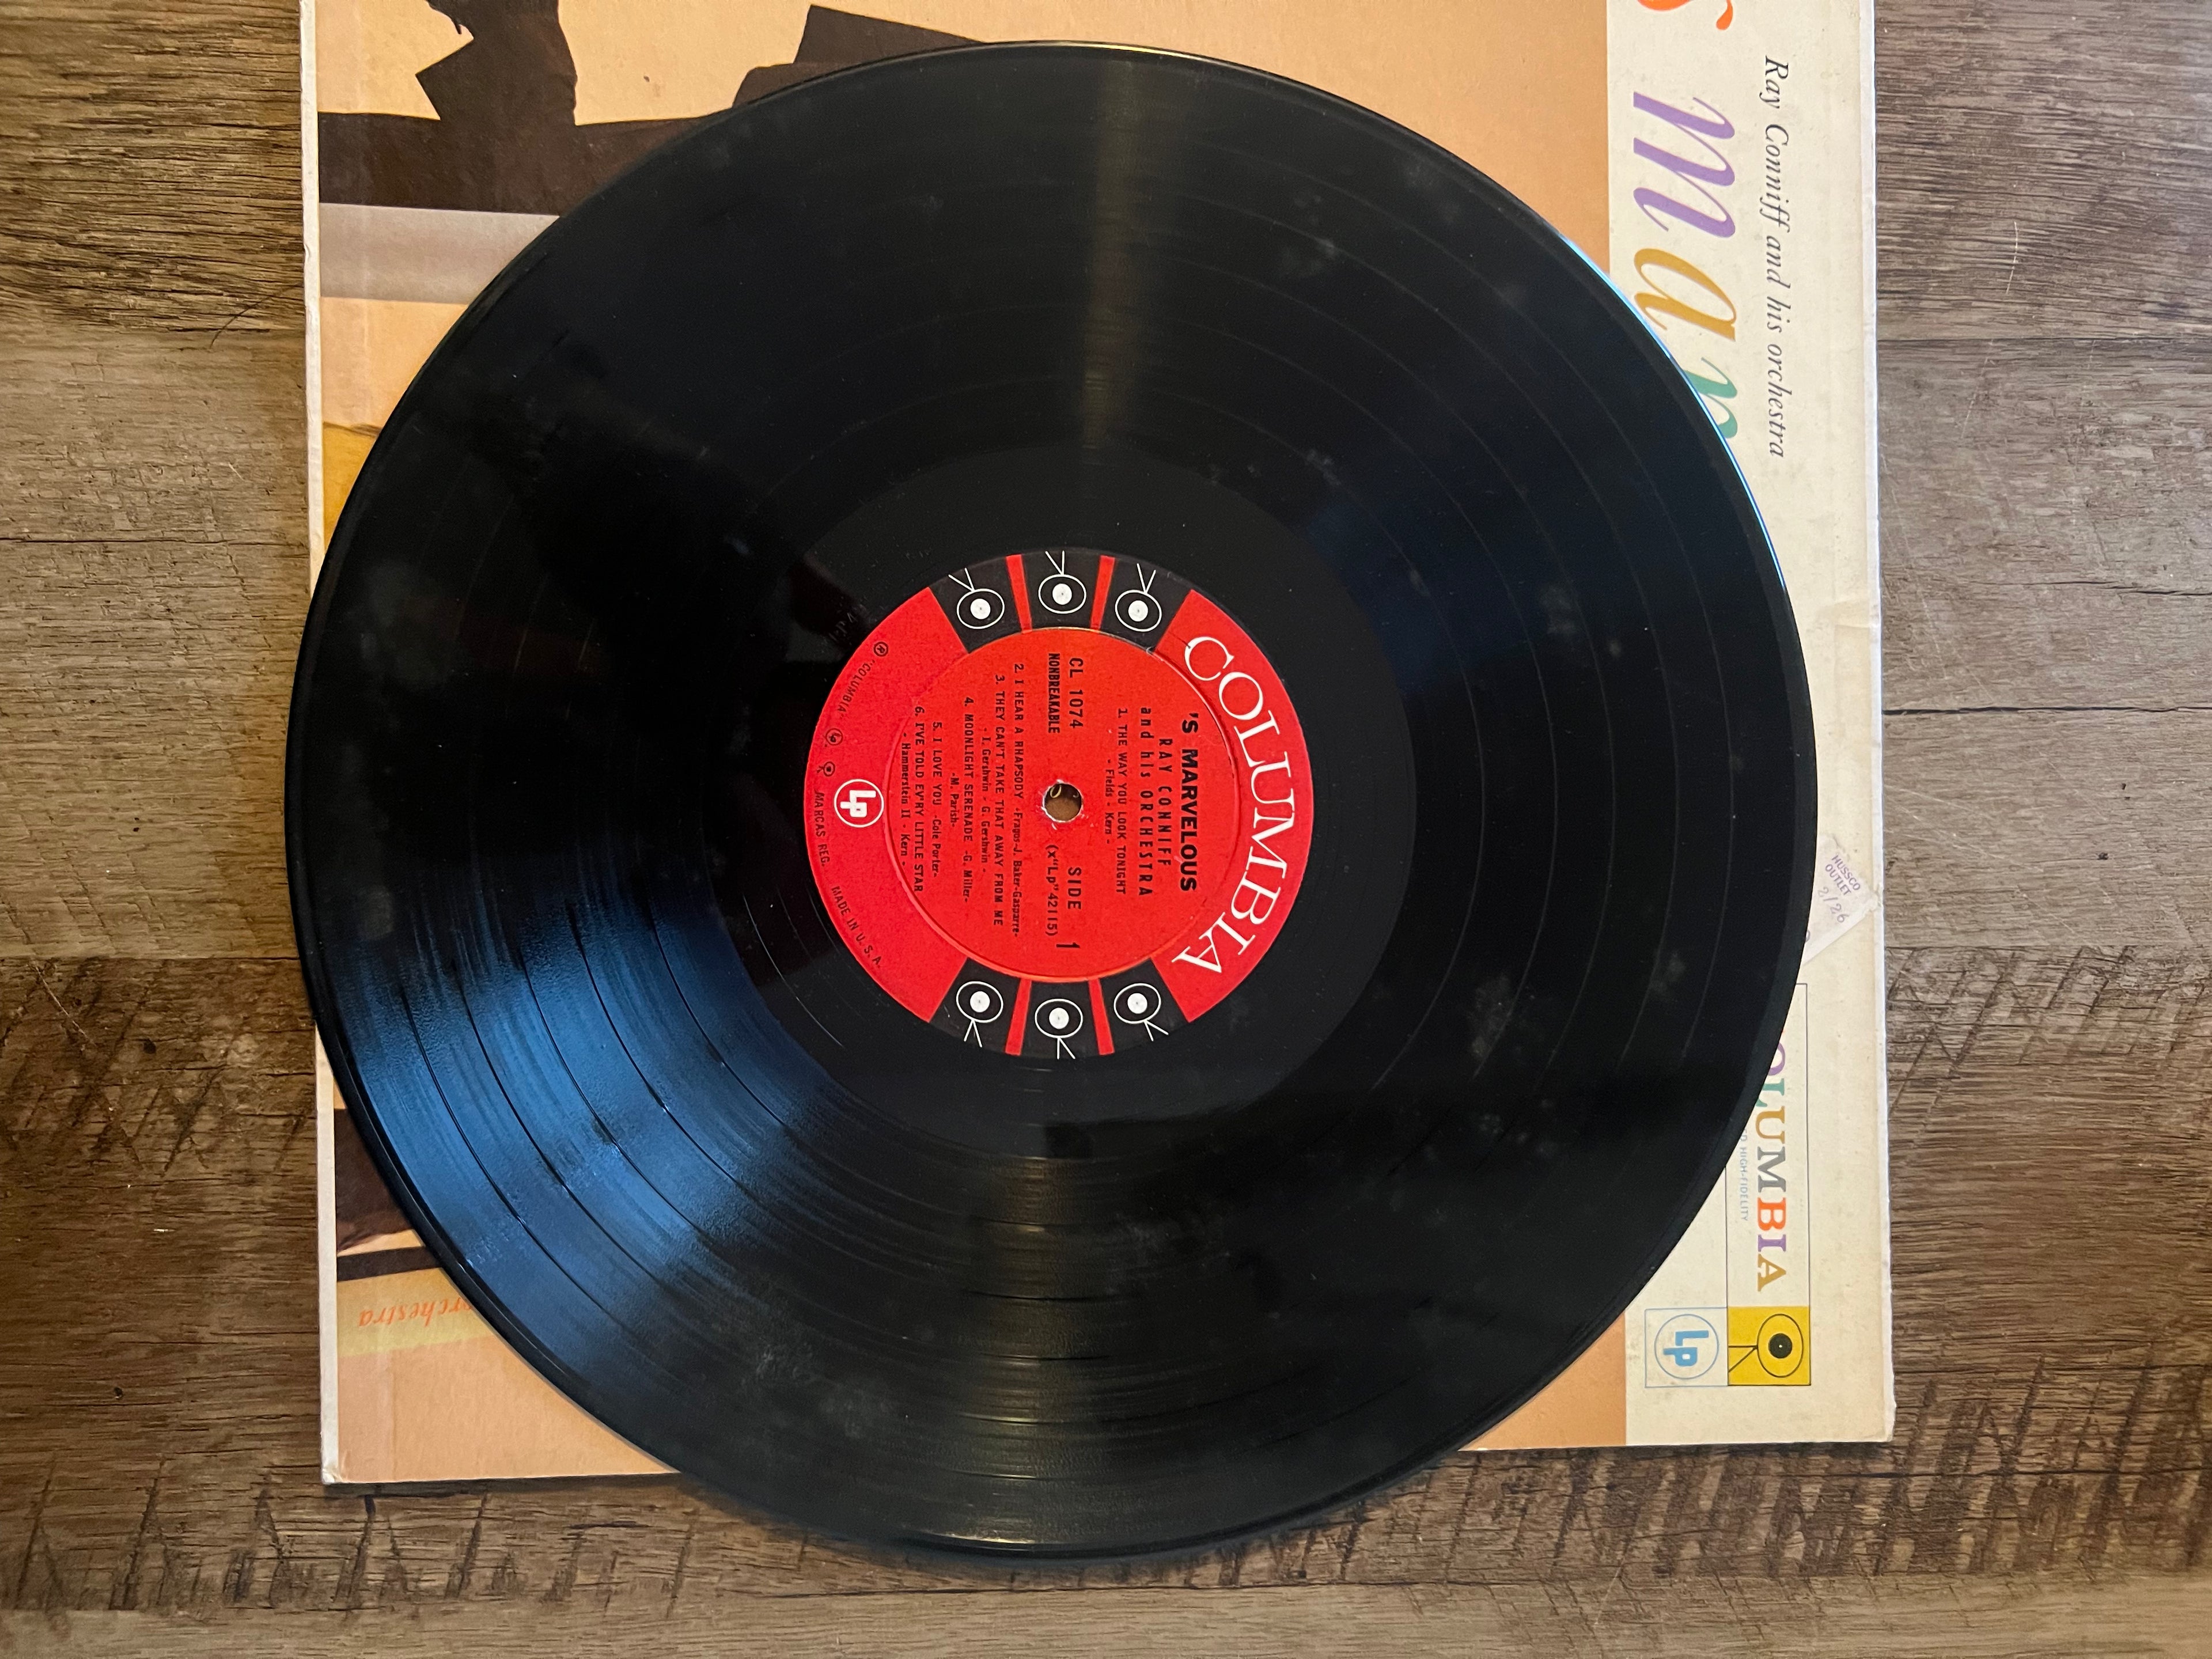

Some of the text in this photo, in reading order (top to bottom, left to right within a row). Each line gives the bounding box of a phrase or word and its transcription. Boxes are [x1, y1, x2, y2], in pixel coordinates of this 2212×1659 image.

[1759, 55, 1792, 457] Ray Conniff and his orchestra
[964, 697, 974, 706] 4.
[1015, 692, 1024, 720] HEAR
[1048, 653, 1060, 733] NONBREAKABLE
[1069, 658, 1084, 728] CL 1074
[933, 722, 942, 731] 5.
[964, 714, 974, 778] MOONLIGHT
[902, 743, 911, 804] Hammerstein
[933, 750, 942, 777] LOVE
[982, 749, 991, 791] Gershwin
[1014, 741, 1023, 798] RHAPSODY
[1105, 770, 1115, 797] Fields
[814, 790, 825, 837] MARCAS
[840, 790, 876, 818] Lp
[902, 809, 910, 818] II
[913, 707, 925, 893] 6. I'VE TOLD EV'RY LITTLE STAR
[933, 785, 942, 805] YOU
[964, 784, 973, 841] SERENADE
[982, 806, 990, 815] G.
[994, 675, 1005, 925] 3. THEY CAN'T TAKE THAT AWAY FROM ME
[1116, 709, 1127, 894] 1. THE WAY YOU LOOK TONIGHT
[1139, 707, 1154, 895] and his ORCHESTRA
[1158, 739, 1173, 865] RAY CONNIFF
[1171, 636, 1295, 974] COLUMBIA
[1180, 713, 1198, 891] 'S MARVELOUS
[901, 834, 910, 855] Kern
[982, 821, 990, 862] Gershwin
[1105, 813, 1114, 834] Kern
[818, 844, 830, 867] REG.
[1831, 855, 1861, 891] HUSSCO
[1067, 868, 1081, 909] SIDE
[1825, 863, 1851, 896] OUTLET
[831, 886, 851, 916] MADE
[847, 918, 859, 931] IN
[1755, 1029, 1787, 1292] OLUMBIA
[1663, 1330, 1710, 1367] Lp
